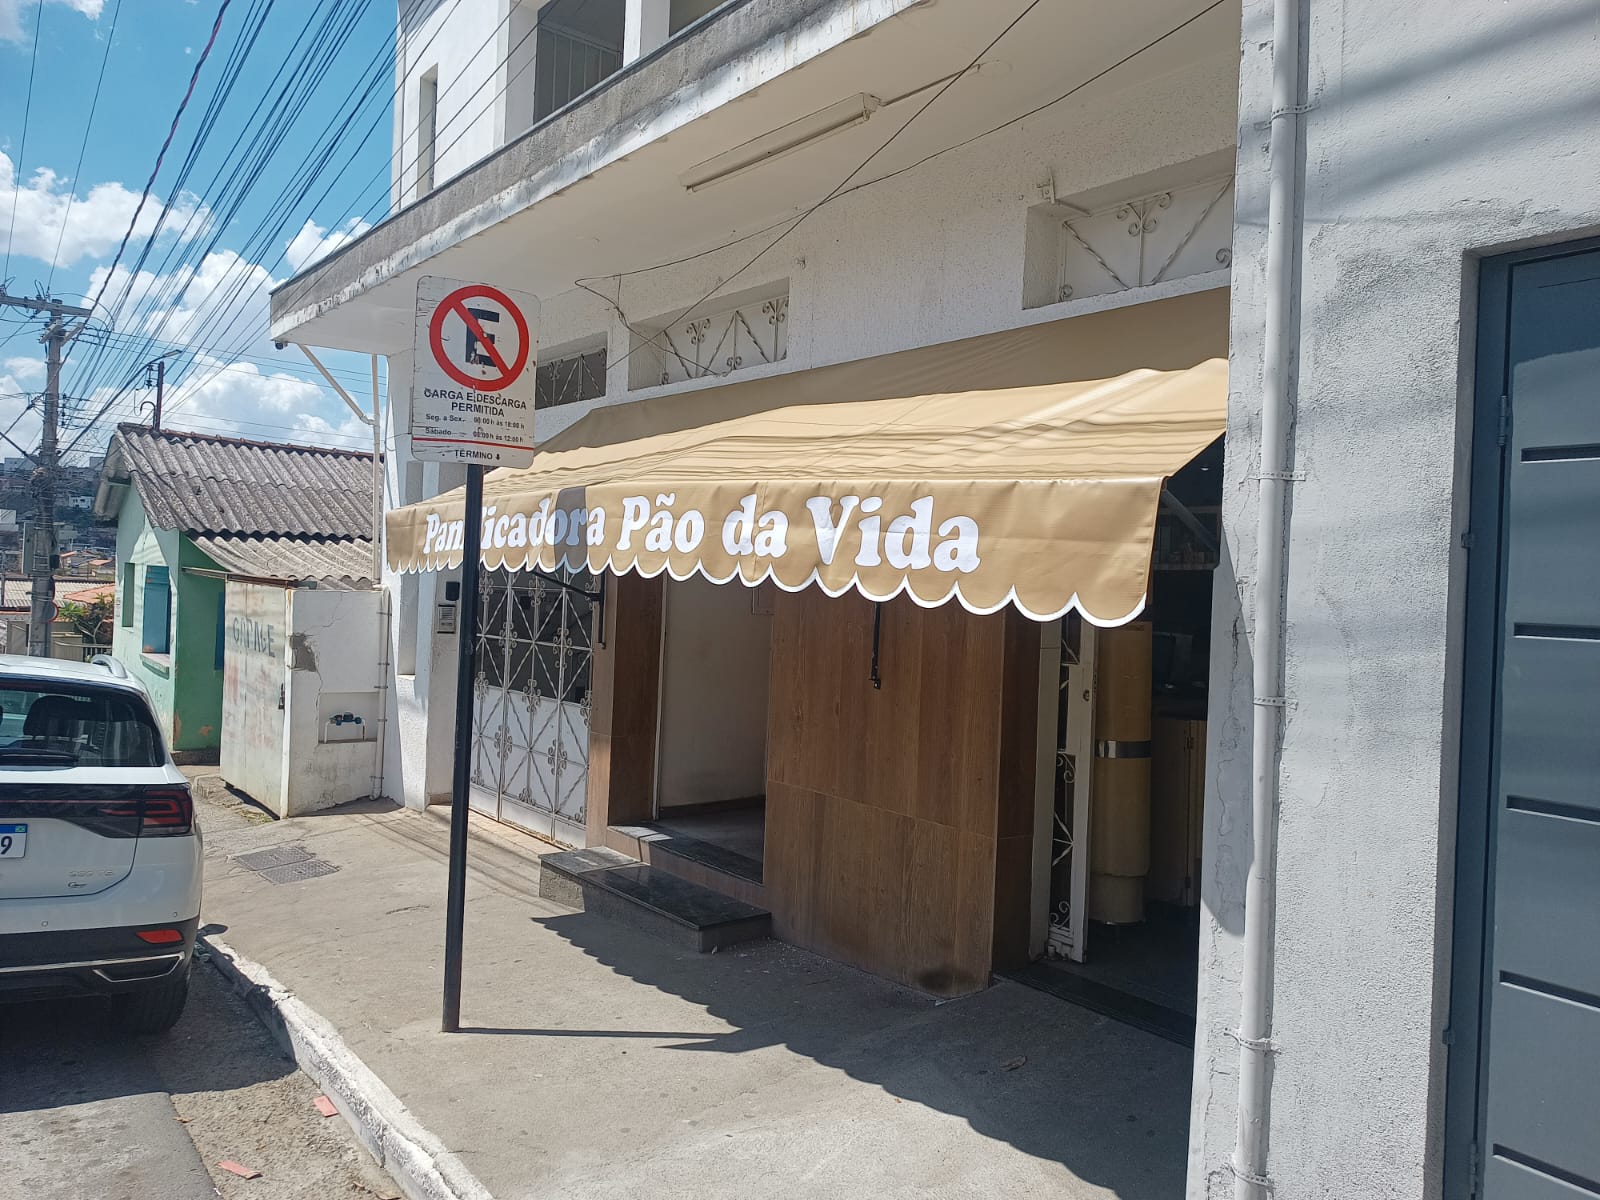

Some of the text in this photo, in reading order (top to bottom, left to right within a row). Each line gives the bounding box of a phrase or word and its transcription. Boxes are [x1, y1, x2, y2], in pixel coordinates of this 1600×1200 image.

[424, 388, 527, 410] CARGA E DESCARGA
[451, 401, 505, 417] PERMITIDA
[423, 491, 982, 574] Panicadora Pão da Vida
